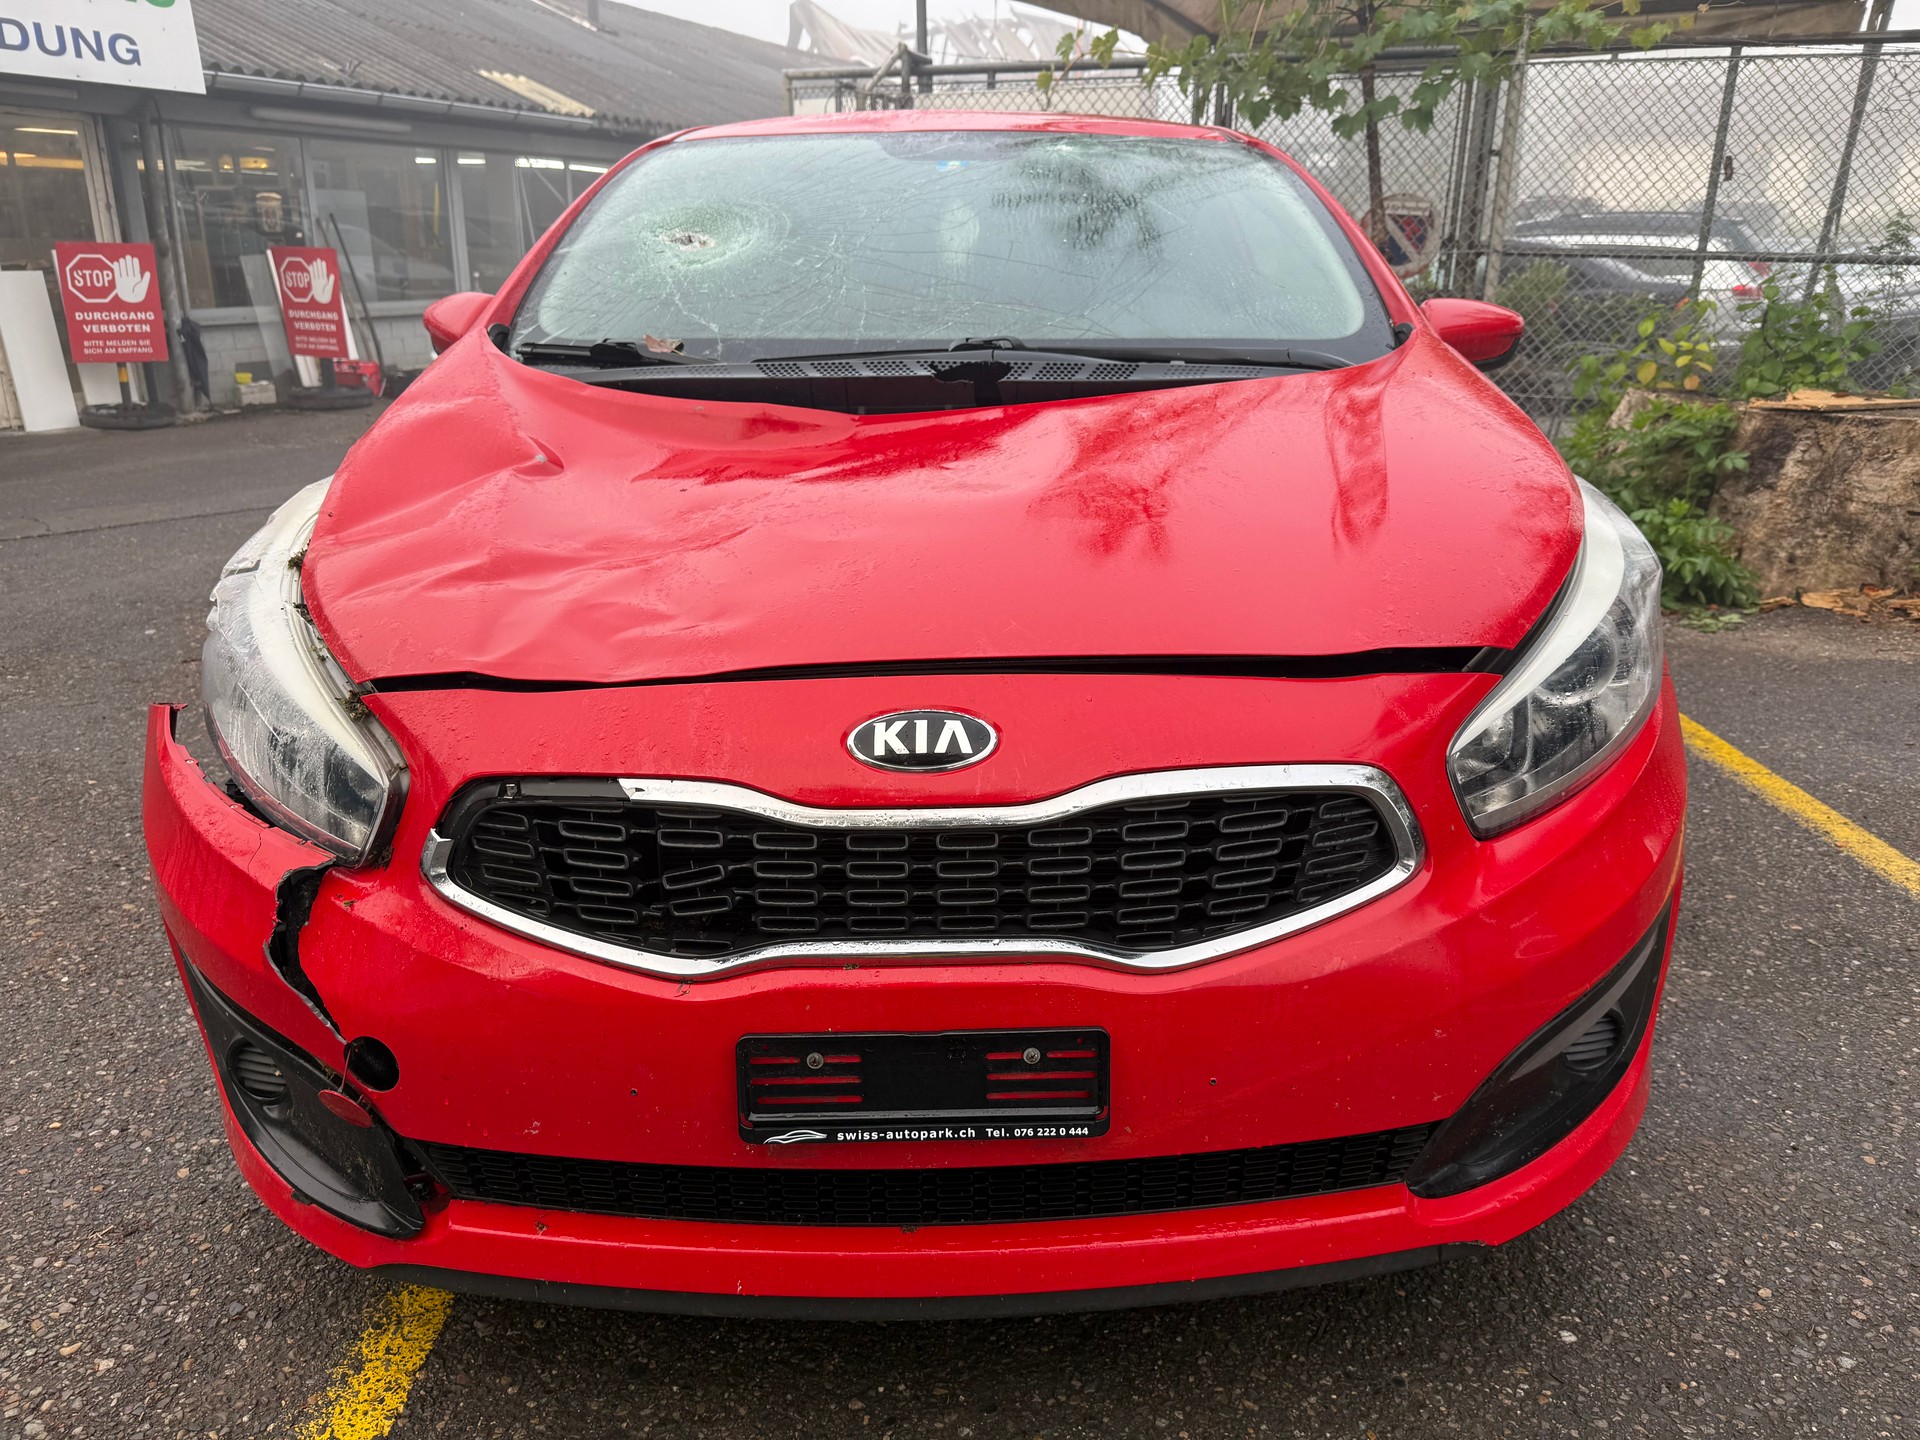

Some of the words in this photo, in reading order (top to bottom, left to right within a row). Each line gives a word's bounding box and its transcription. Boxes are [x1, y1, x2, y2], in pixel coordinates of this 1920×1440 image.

[73, 269, 113, 287] STOP
[285, 271, 310, 288] STOP
[75, 311, 155, 321] DURCHGANG
[288, 309, 339, 321] DURCHGANG
[82, 323, 151, 333] VERBOTEN
[294, 321, 337, 332] VERBOTEN
[872, 719, 974, 756] KIA
[836, 1127, 976, 1141] swiss-autopark.ch
[985, 1127, 1010, 1137] Tel.
[1014, 1128, 1034, 1137] 076
[1037, 1127, 1057, 1136] 222
[1059, 1127, 1066, 1136] 0
[1068, 1127, 1089, 1136] 444
